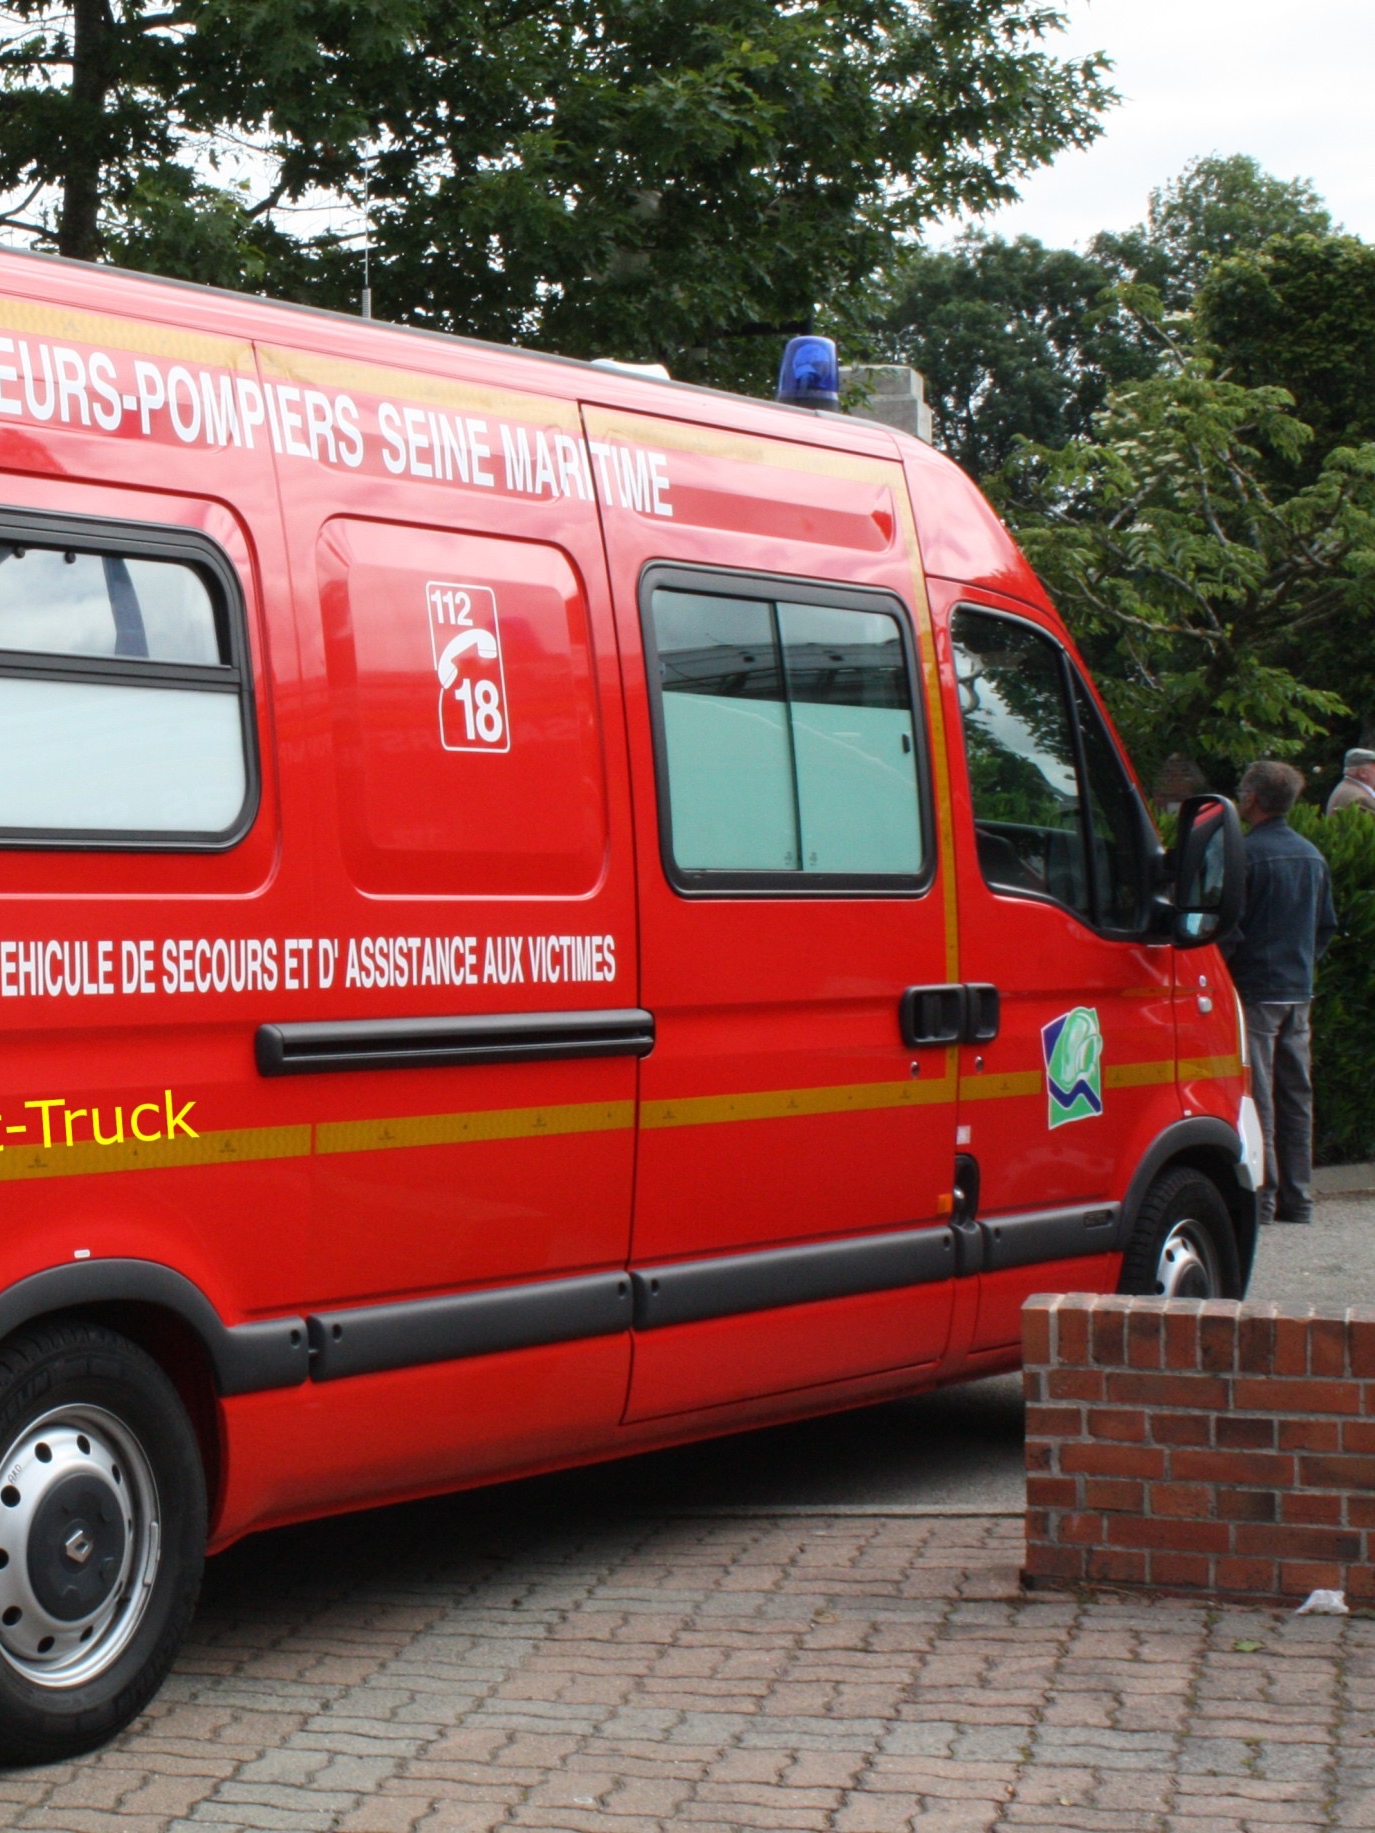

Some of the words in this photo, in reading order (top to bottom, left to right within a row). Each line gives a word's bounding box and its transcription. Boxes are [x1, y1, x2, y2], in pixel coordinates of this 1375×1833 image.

[378, 402, 494, 487] SEINE
[499, 424, 673, 517] MARITIME
[431, 590, 473, 626] 112
[455, 678, 502, 742] 18
[122, 941, 156, 994] DE
[163, 938, 279, 993] SECOURS
[284, 938, 312, 990] ET
[345, 936, 478, 988] ASSISTANCE
[483, 936, 524, 984] AUX
[528, 935, 616, 983] VICTIMES
